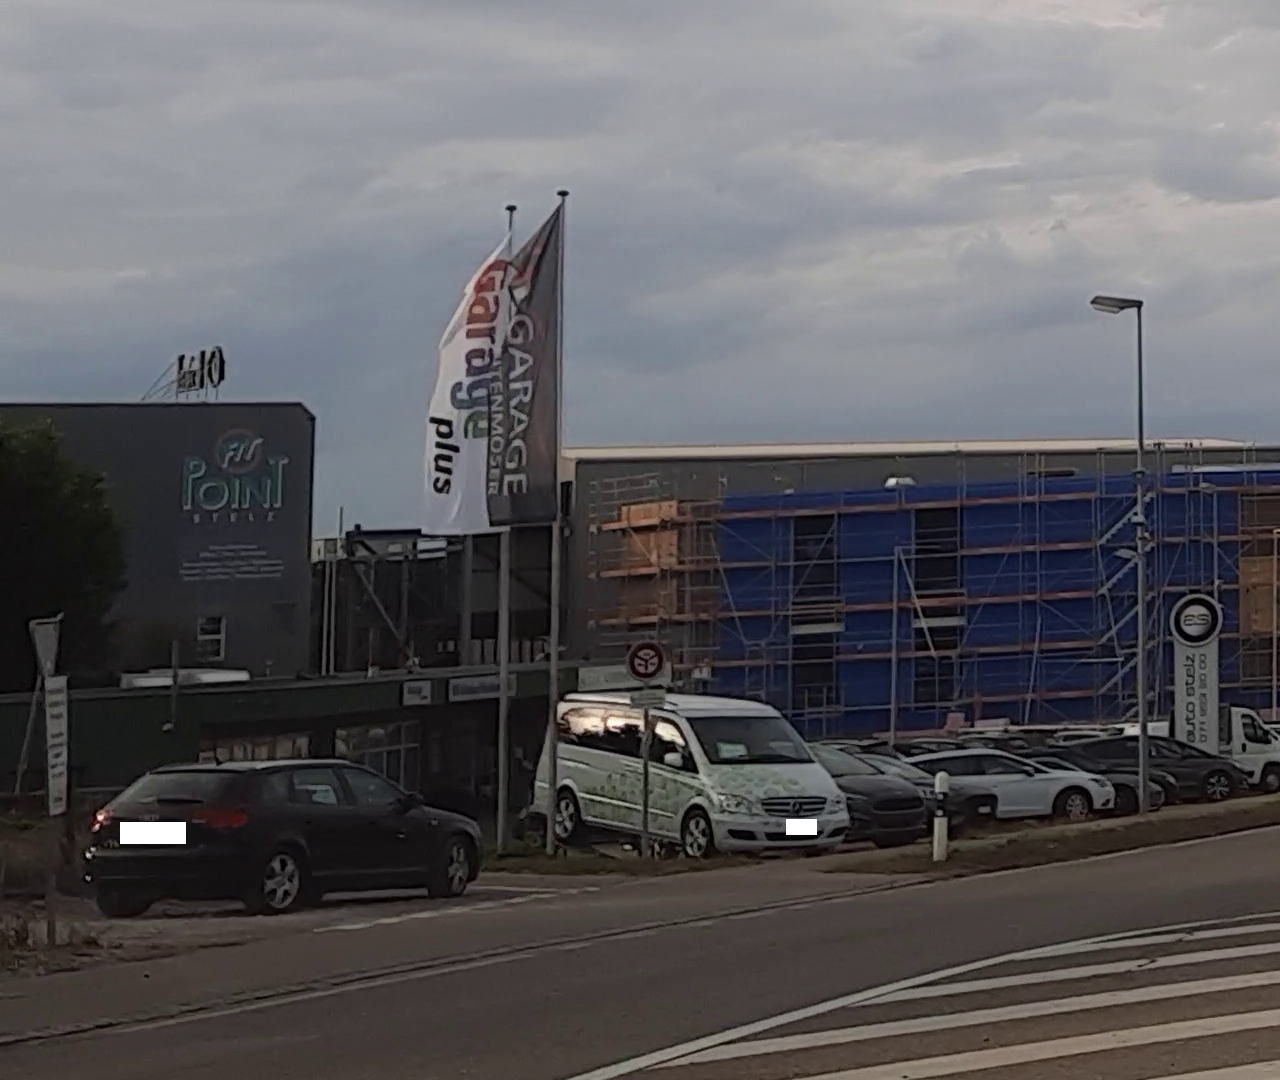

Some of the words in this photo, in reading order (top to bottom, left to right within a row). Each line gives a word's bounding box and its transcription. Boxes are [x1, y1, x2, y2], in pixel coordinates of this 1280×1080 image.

[503, 313, 534, 497] GARAGE
[429, 416, 460, 495] plus
[1185, 701, 1196, 743] auto
